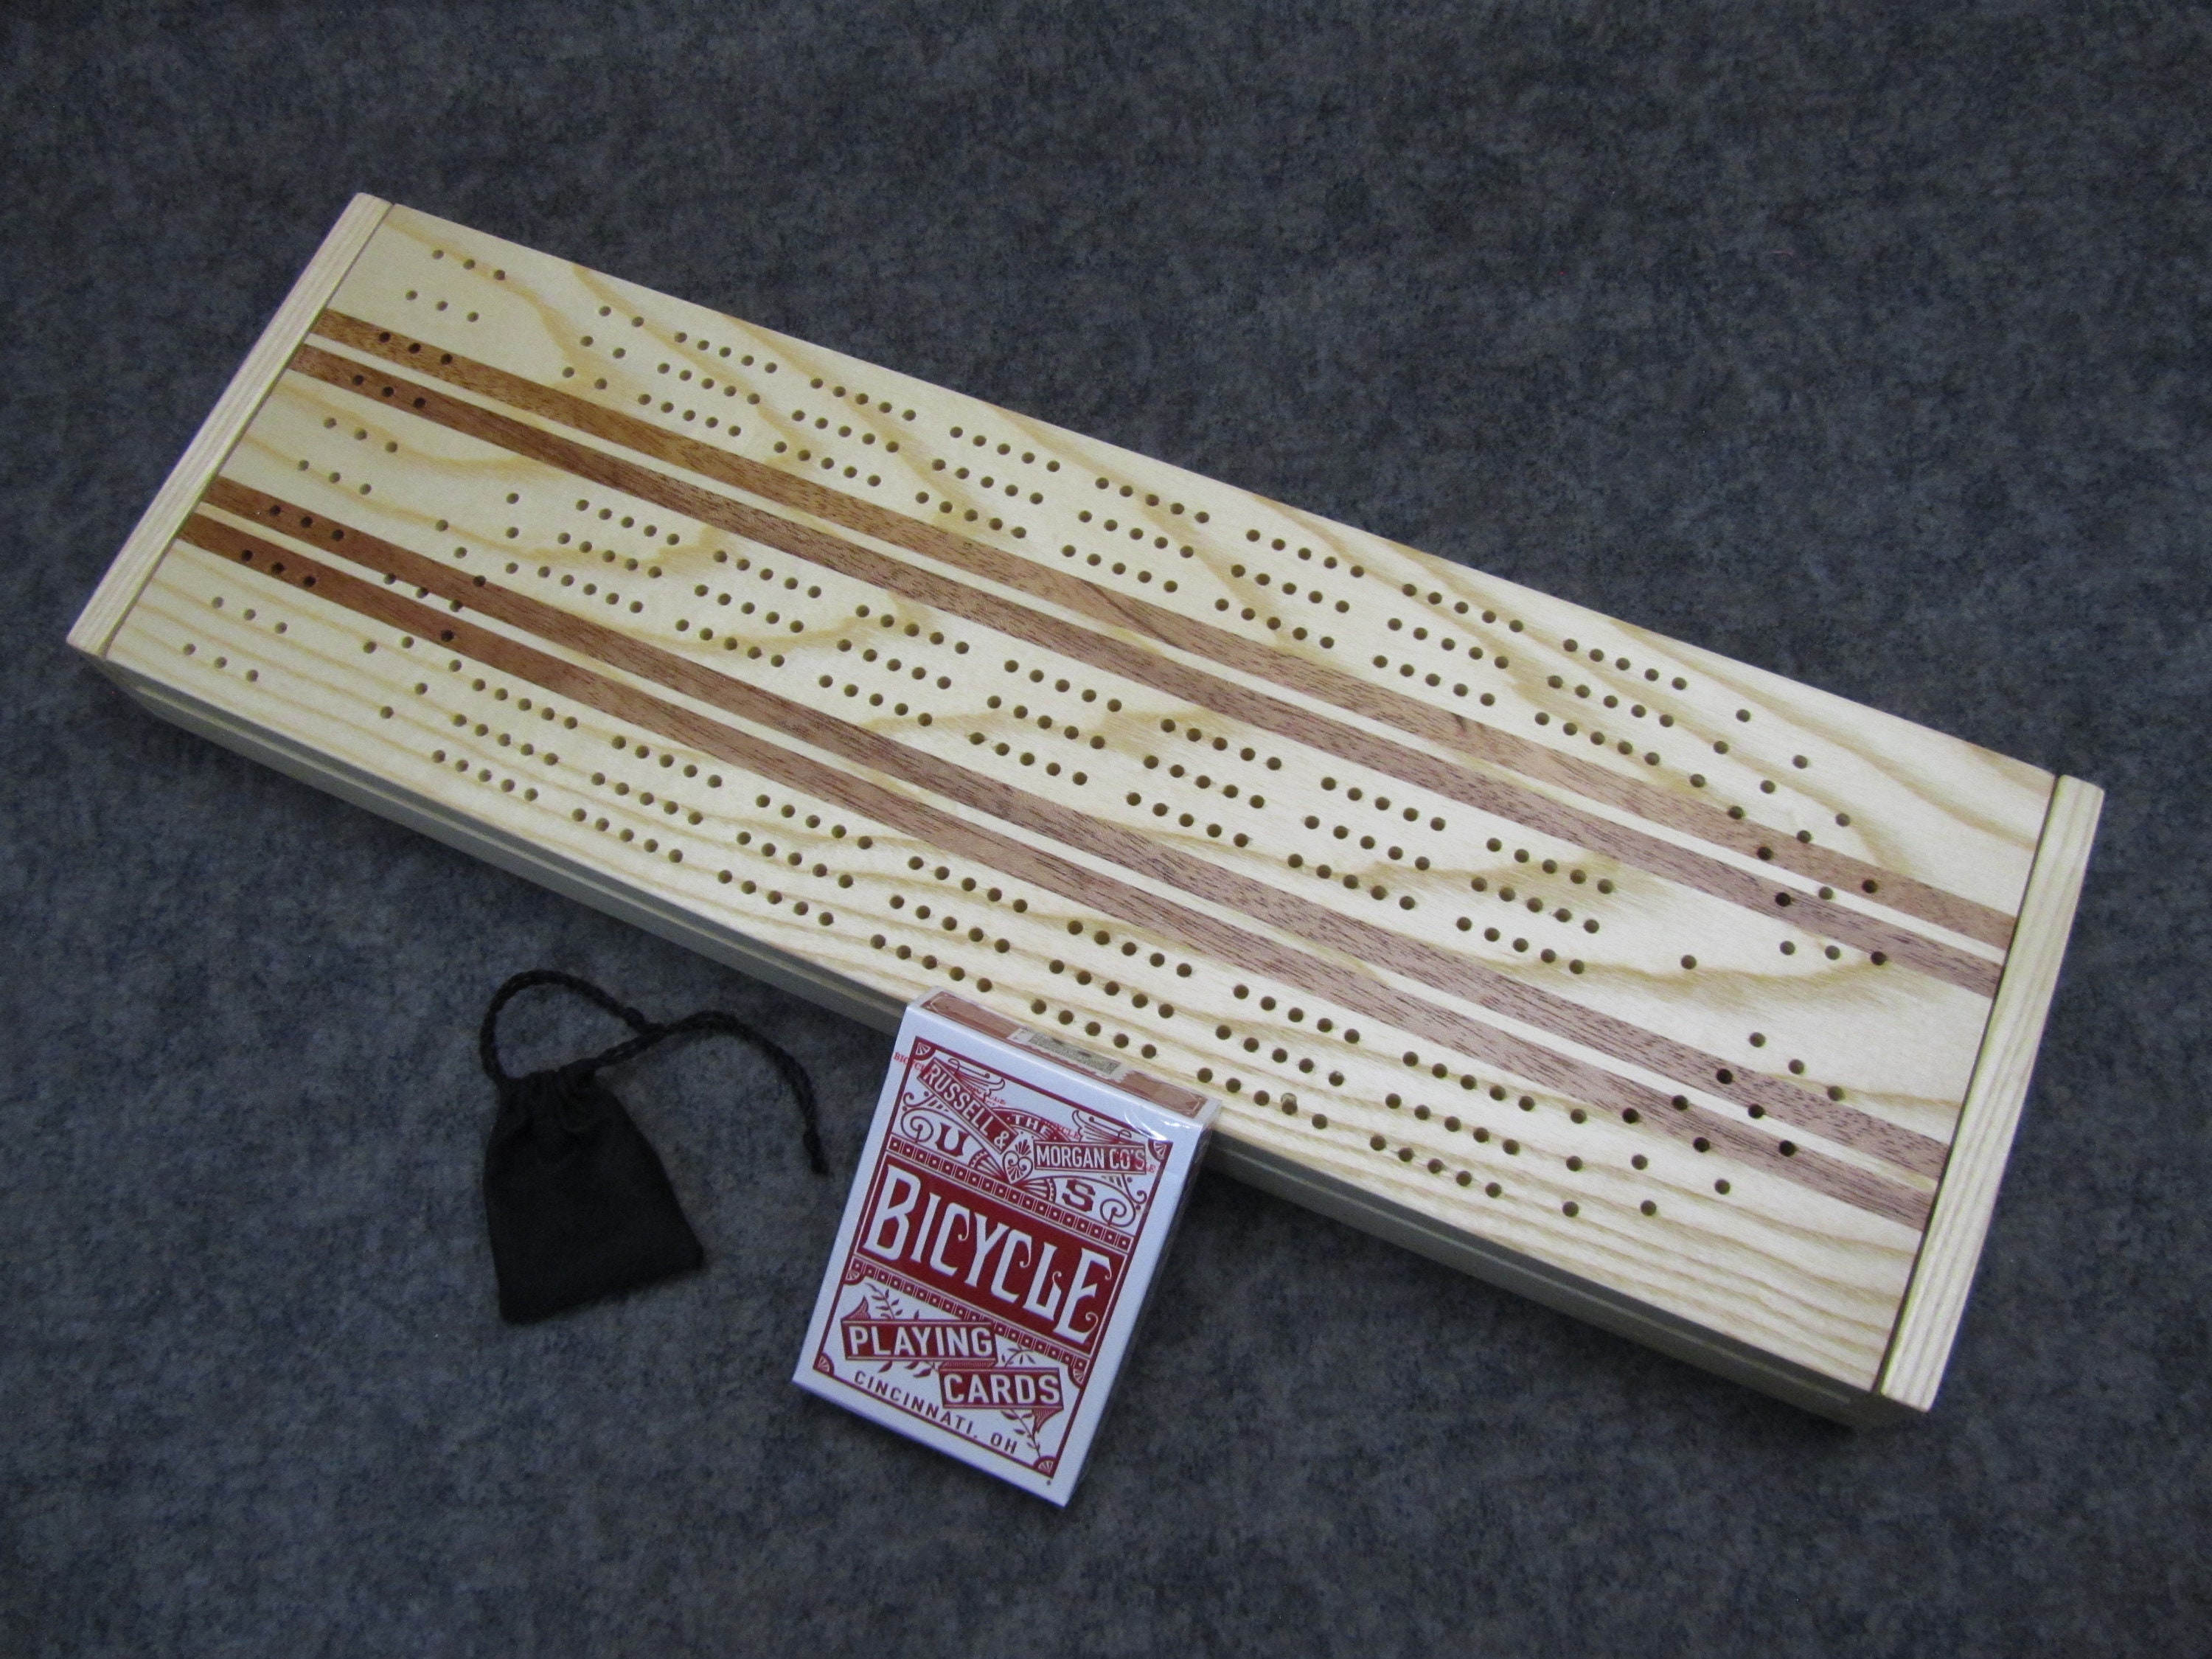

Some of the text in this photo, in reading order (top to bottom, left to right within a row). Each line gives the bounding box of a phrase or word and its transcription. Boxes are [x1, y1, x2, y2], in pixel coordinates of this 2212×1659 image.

[923, 1064, 994, 1136] RUSSELL
[993, 1130, 1009, 1149] &
[1011, 1113, 1054, 1135] THE
[935, 1121, 1096, 1213] U S
[1035, 1145, 1105, 1169] MORGAN
[1109, 1147, 1146, 1171] CO'S
[862, 1164, 1112, 1345] BICYCLE
[849, 1325, 993, 1357] PLAYING
[943, 1374, 1061, 1405] CARDS
[990, 1431, 1018, 1455] OH
